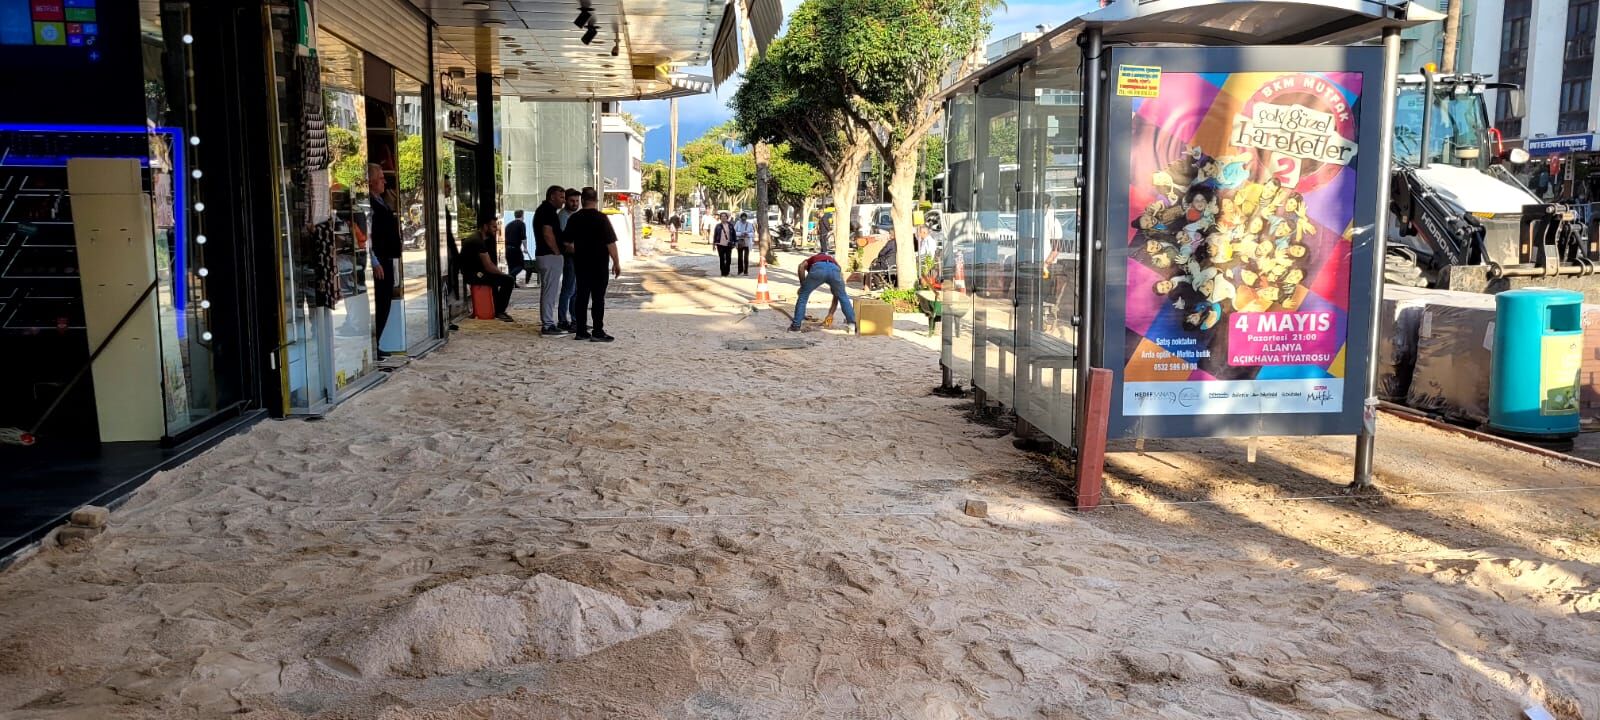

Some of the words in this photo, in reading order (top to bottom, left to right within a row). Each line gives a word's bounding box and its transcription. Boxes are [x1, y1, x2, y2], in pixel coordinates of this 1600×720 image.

[1261, 77, 1295, 98] BKM
[1303, 77, 1349, 122] MUTFAK
[1259, 108, 1284, 124] çok
[1285, 108, 1333, 133] güzel
[1236, 120, 1352, 161] hareketler
[1273, 157, 1296, 184] 2
[1235, 314, 1249, 333] 4
[1257, 312, 1331, 333] MAYIS
[1247, 333, 1288, 342] Pazartesi
[1291, 333, 1317, 341] 21:00
[1262, 343, 1303, 352] ALANYA
[1232, 355, 1280, 365] AÇIKHAVA
[1281, 353, 1331, 363] TİYATROSU
